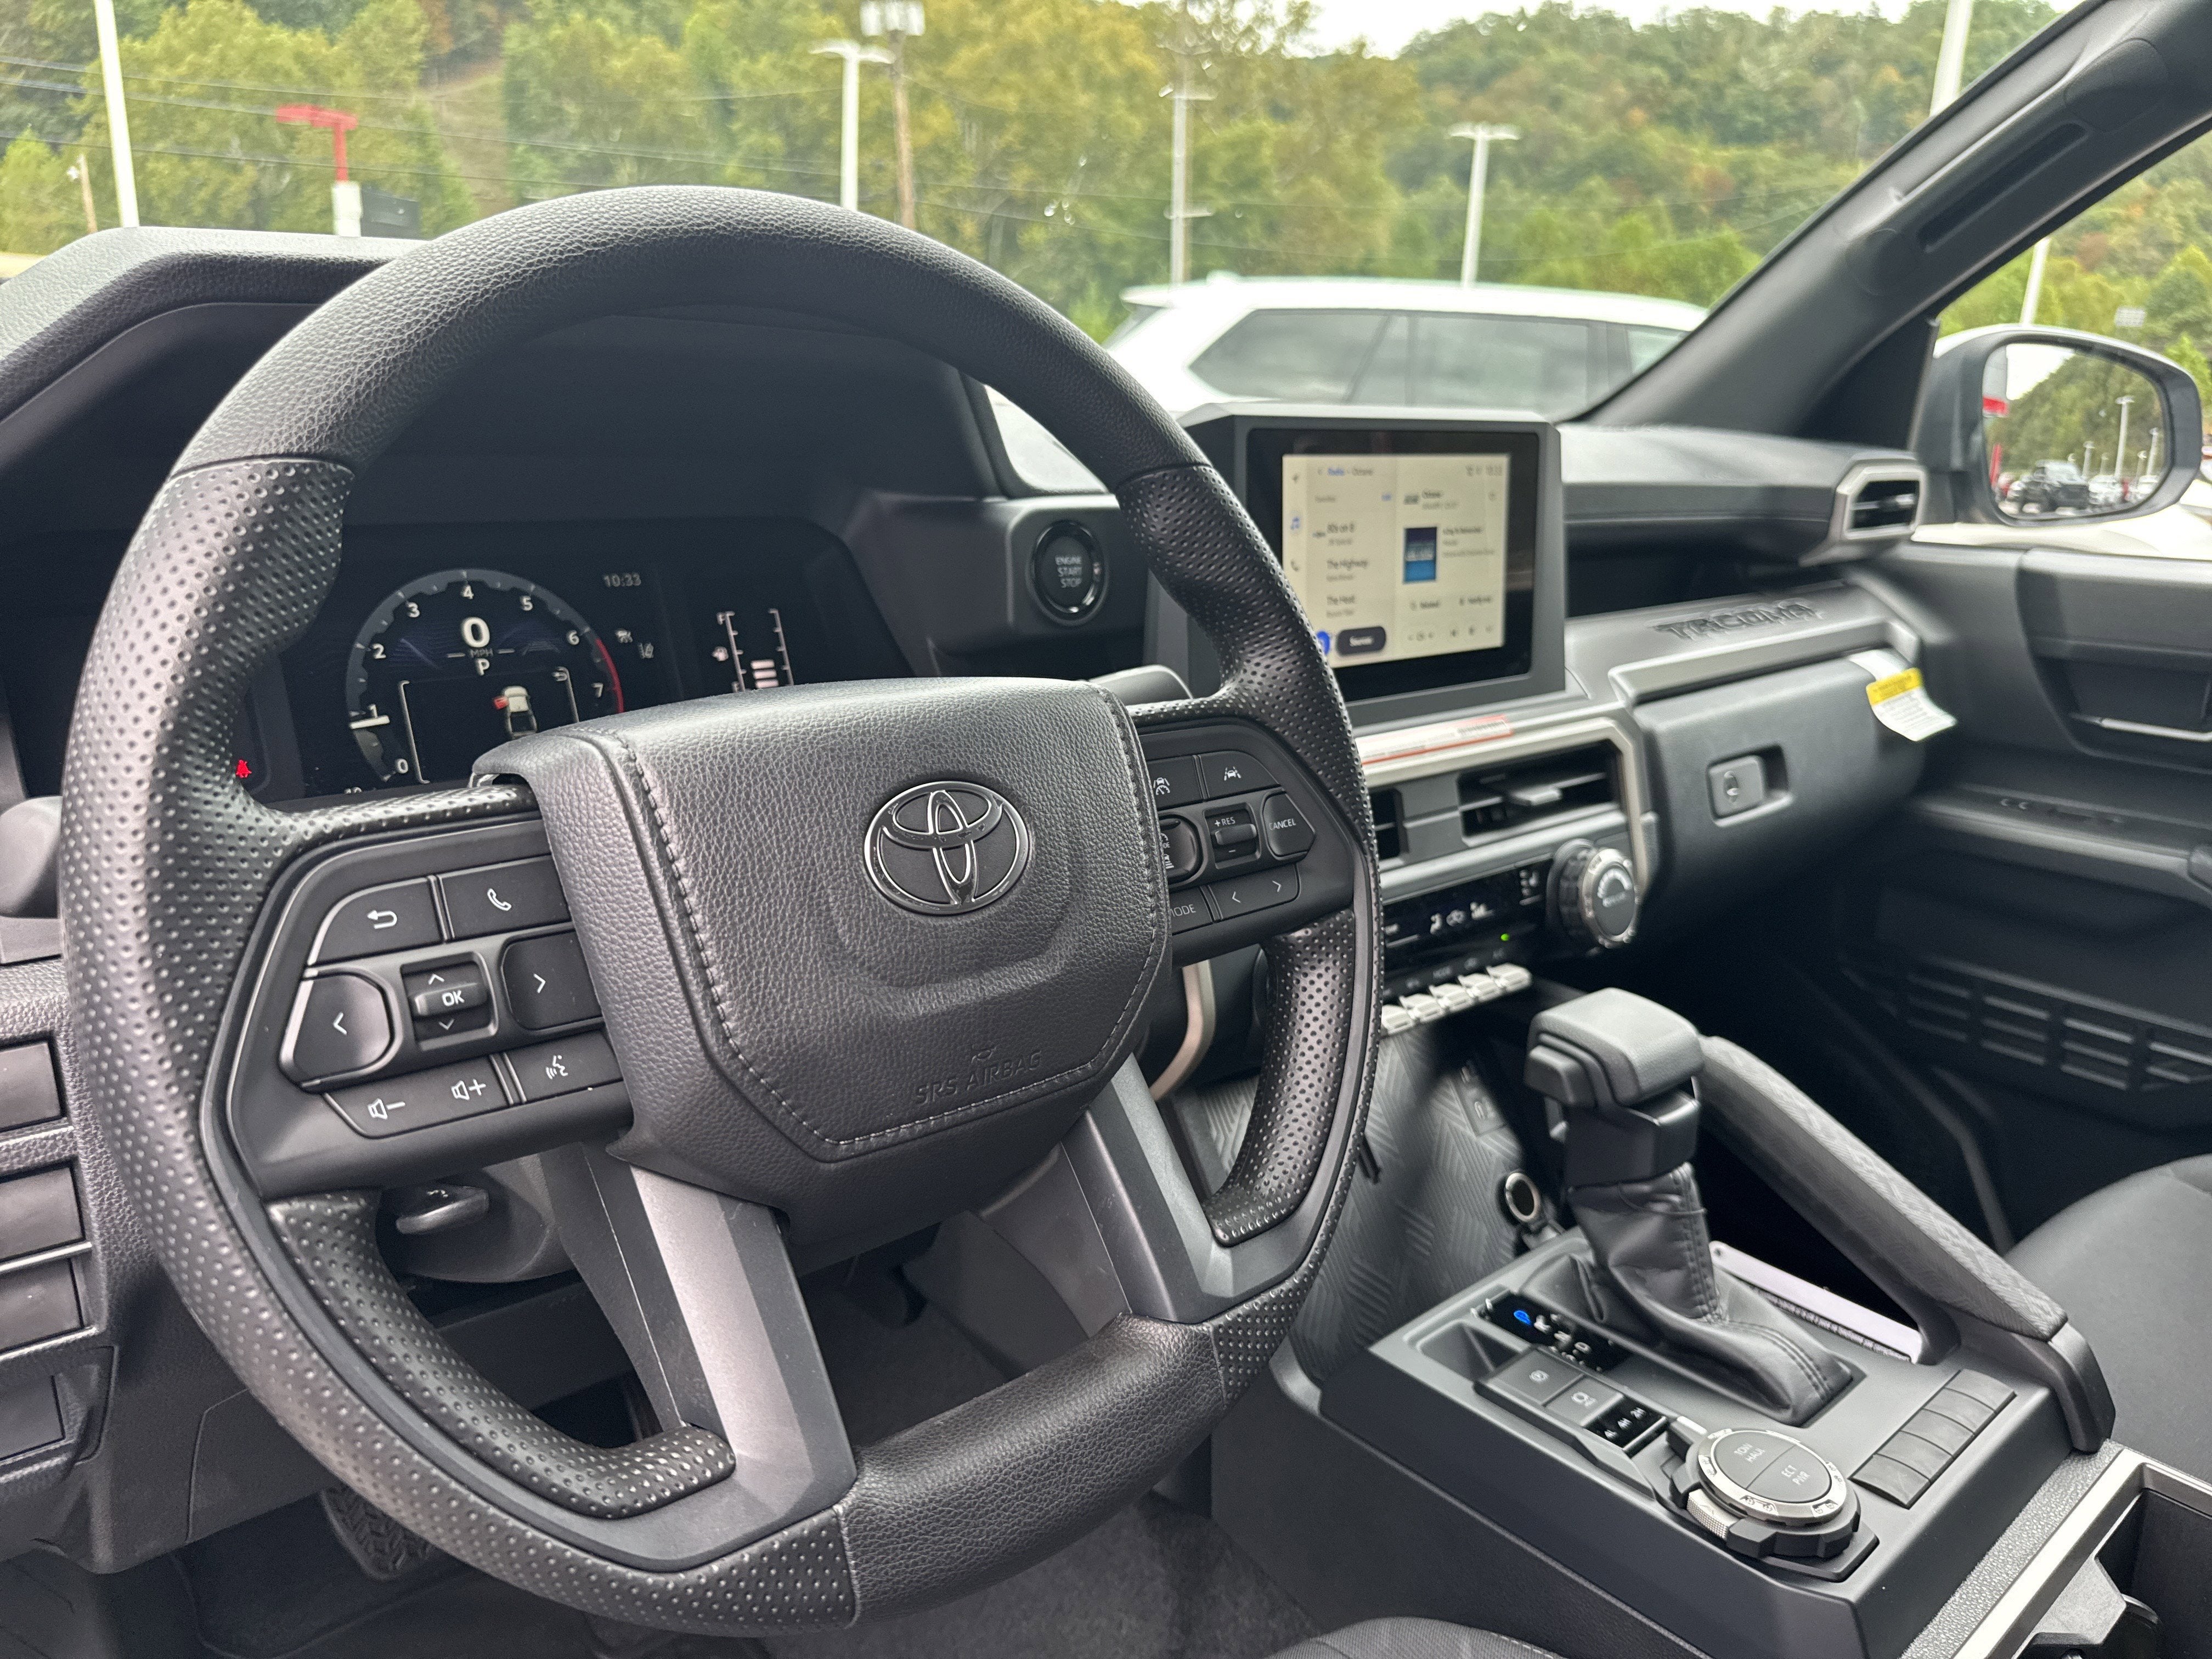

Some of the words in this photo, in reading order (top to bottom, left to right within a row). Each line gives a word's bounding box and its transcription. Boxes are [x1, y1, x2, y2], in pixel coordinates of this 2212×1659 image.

[603, 572, 642, 588] 10:33
[1060, 578, 1081, 588] STOP
[461, 584, 474, 600] 4
[407, 602, 420, 618] 3
[520, 595, 533, 611] 5
[1655, 602, 1818, 641] TACOMA
[461, 616, 490, 647] 0
[566, 629, 580, 646] 6
[371, 643, 386, 659] 2
[471, 648, 494, 658] MPH
[475, 658, 490, 675] P
[592, 682, 603, 698] 7
[367, 703, 379, 718] 1
[396, 758, 409, 774] 0
[1269, 818, 1296, 831] CANCEL
[442, 989, 465, 1007] OK
[914, 1079, 958, 1106] SRS
[967, 1049, 1042, 1090] AIRBAG
[1734, 1443, 1754, 1457] TOW
[1745, 1447, 1766, 1463] HAUL
[1781, 1464, 1797, 1478] ECT
